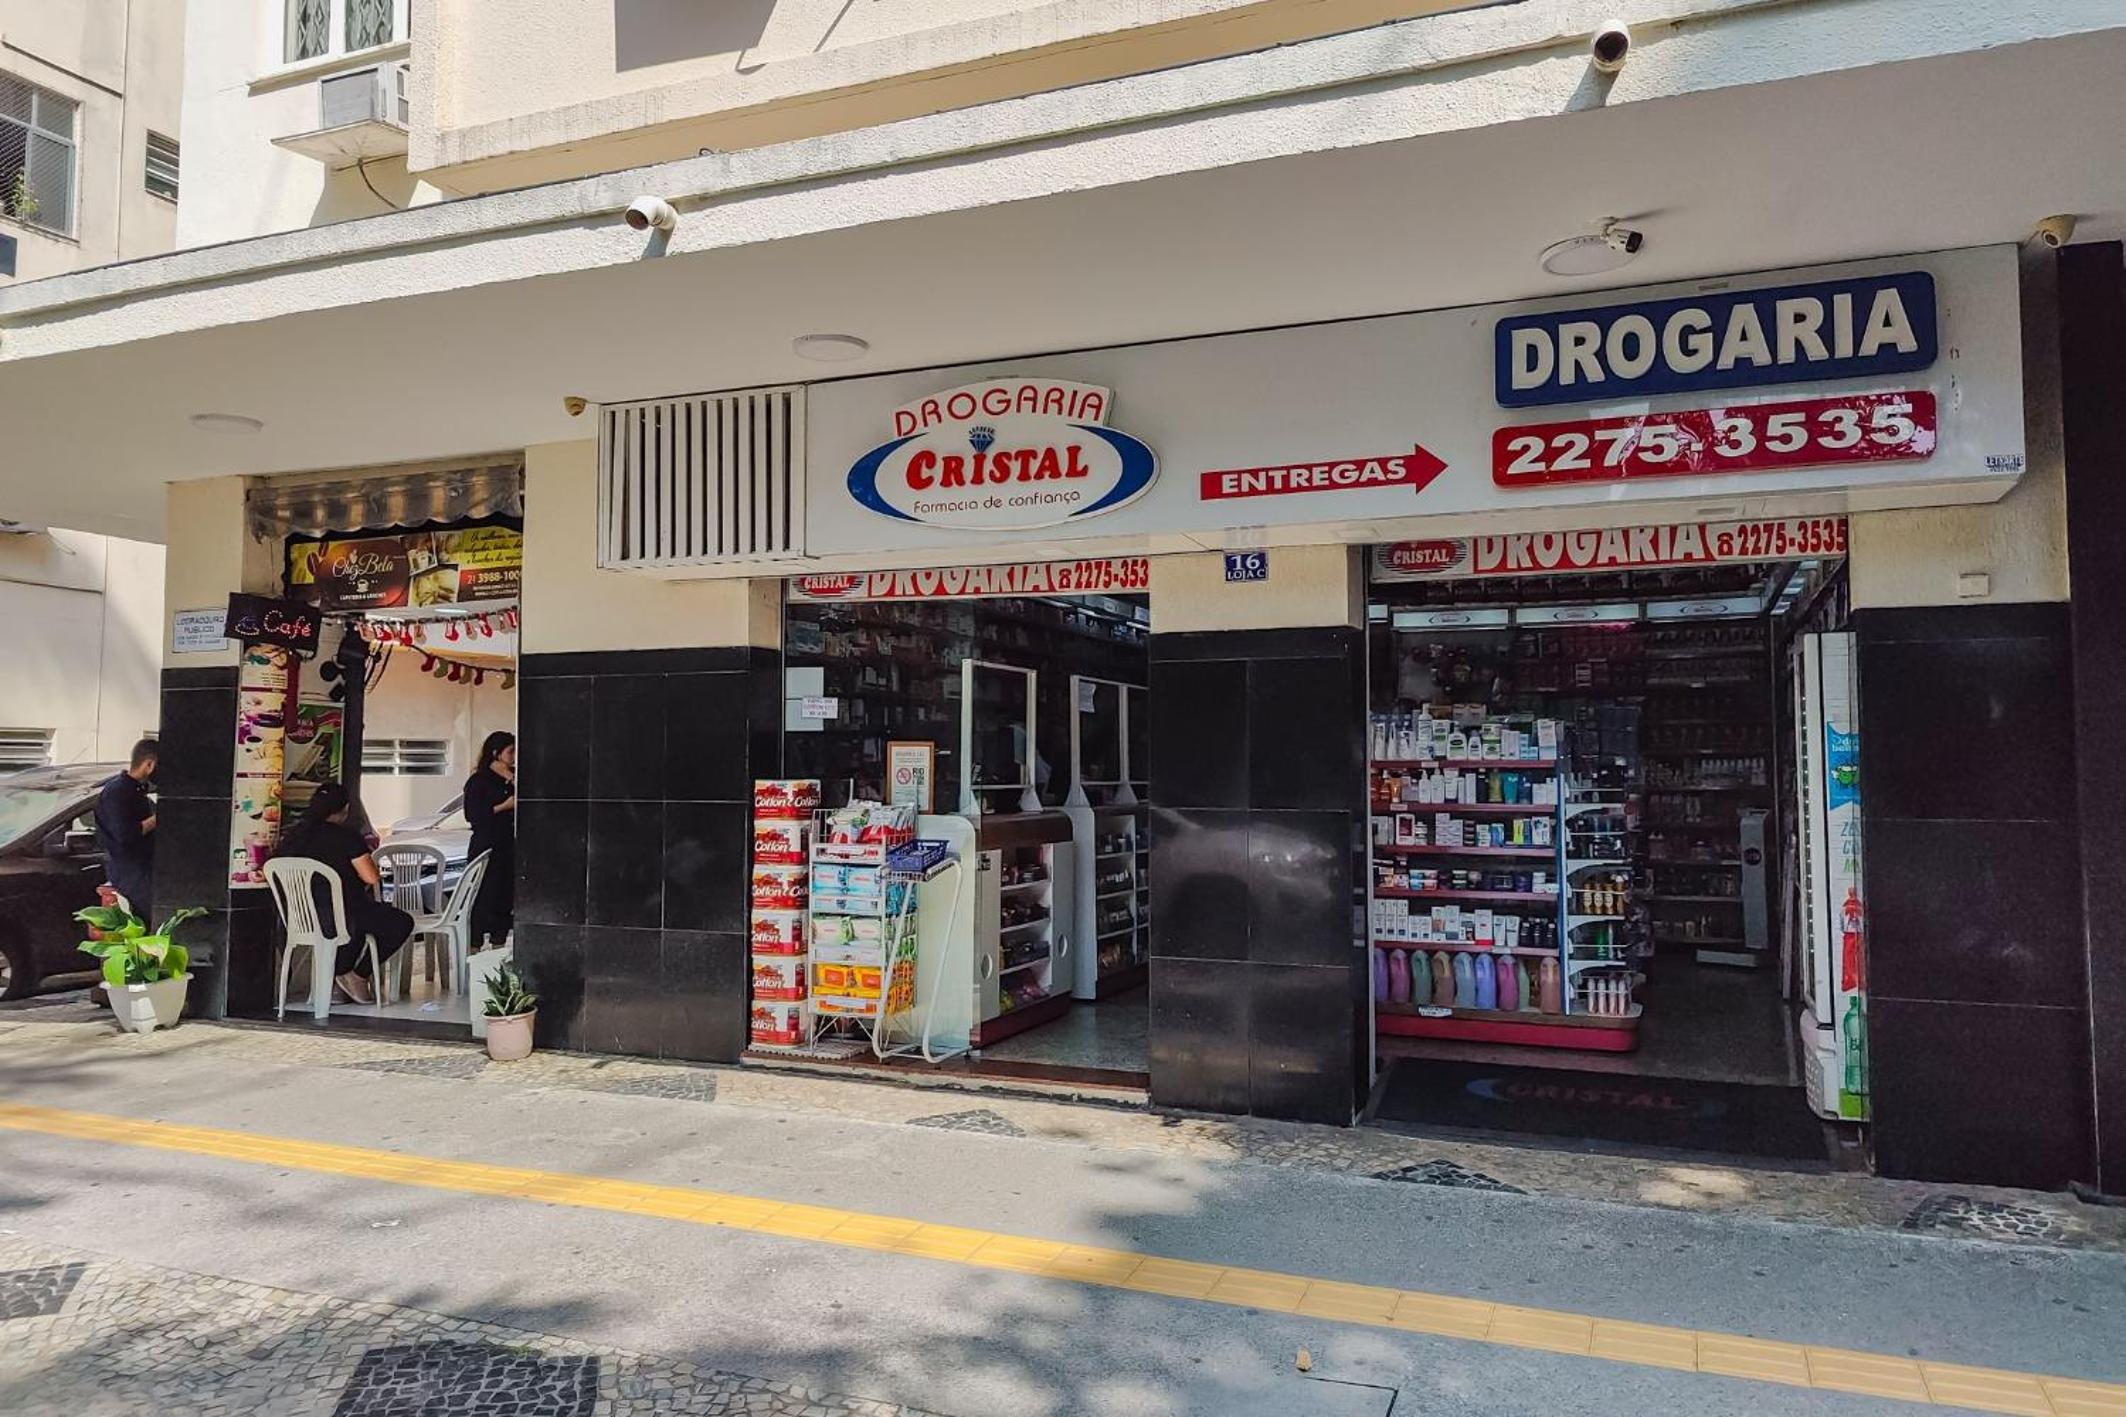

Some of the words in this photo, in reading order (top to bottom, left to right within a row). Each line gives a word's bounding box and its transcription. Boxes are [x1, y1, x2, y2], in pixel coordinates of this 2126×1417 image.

[1511, 288, 1918, 390] DROGARIA
[895, 384, 1103, 437] DROGARIA
[905, 445, 1089, 491] CRISTAL
[1221, 458, 1407, 494] ENTREGAS
[983, 495, 1003, 509] de
[1008, 490, 1081, 508] confiança
[1392, 547, 1450, 565] CRISTAL
[1477, 525, 1705, 571] DROGARIA
[1737, 518, 1848, 556] 2275-3535
[1227, 569, 1254, 580] LOJA
[1256, 569, 1265, 578] C
[1230, 554, 1260, 571] 16
[803, 575, 850, 589] CRISTAL
[263, 610, 312, 640] Café
[752, 1019, 775, 1032] otton
